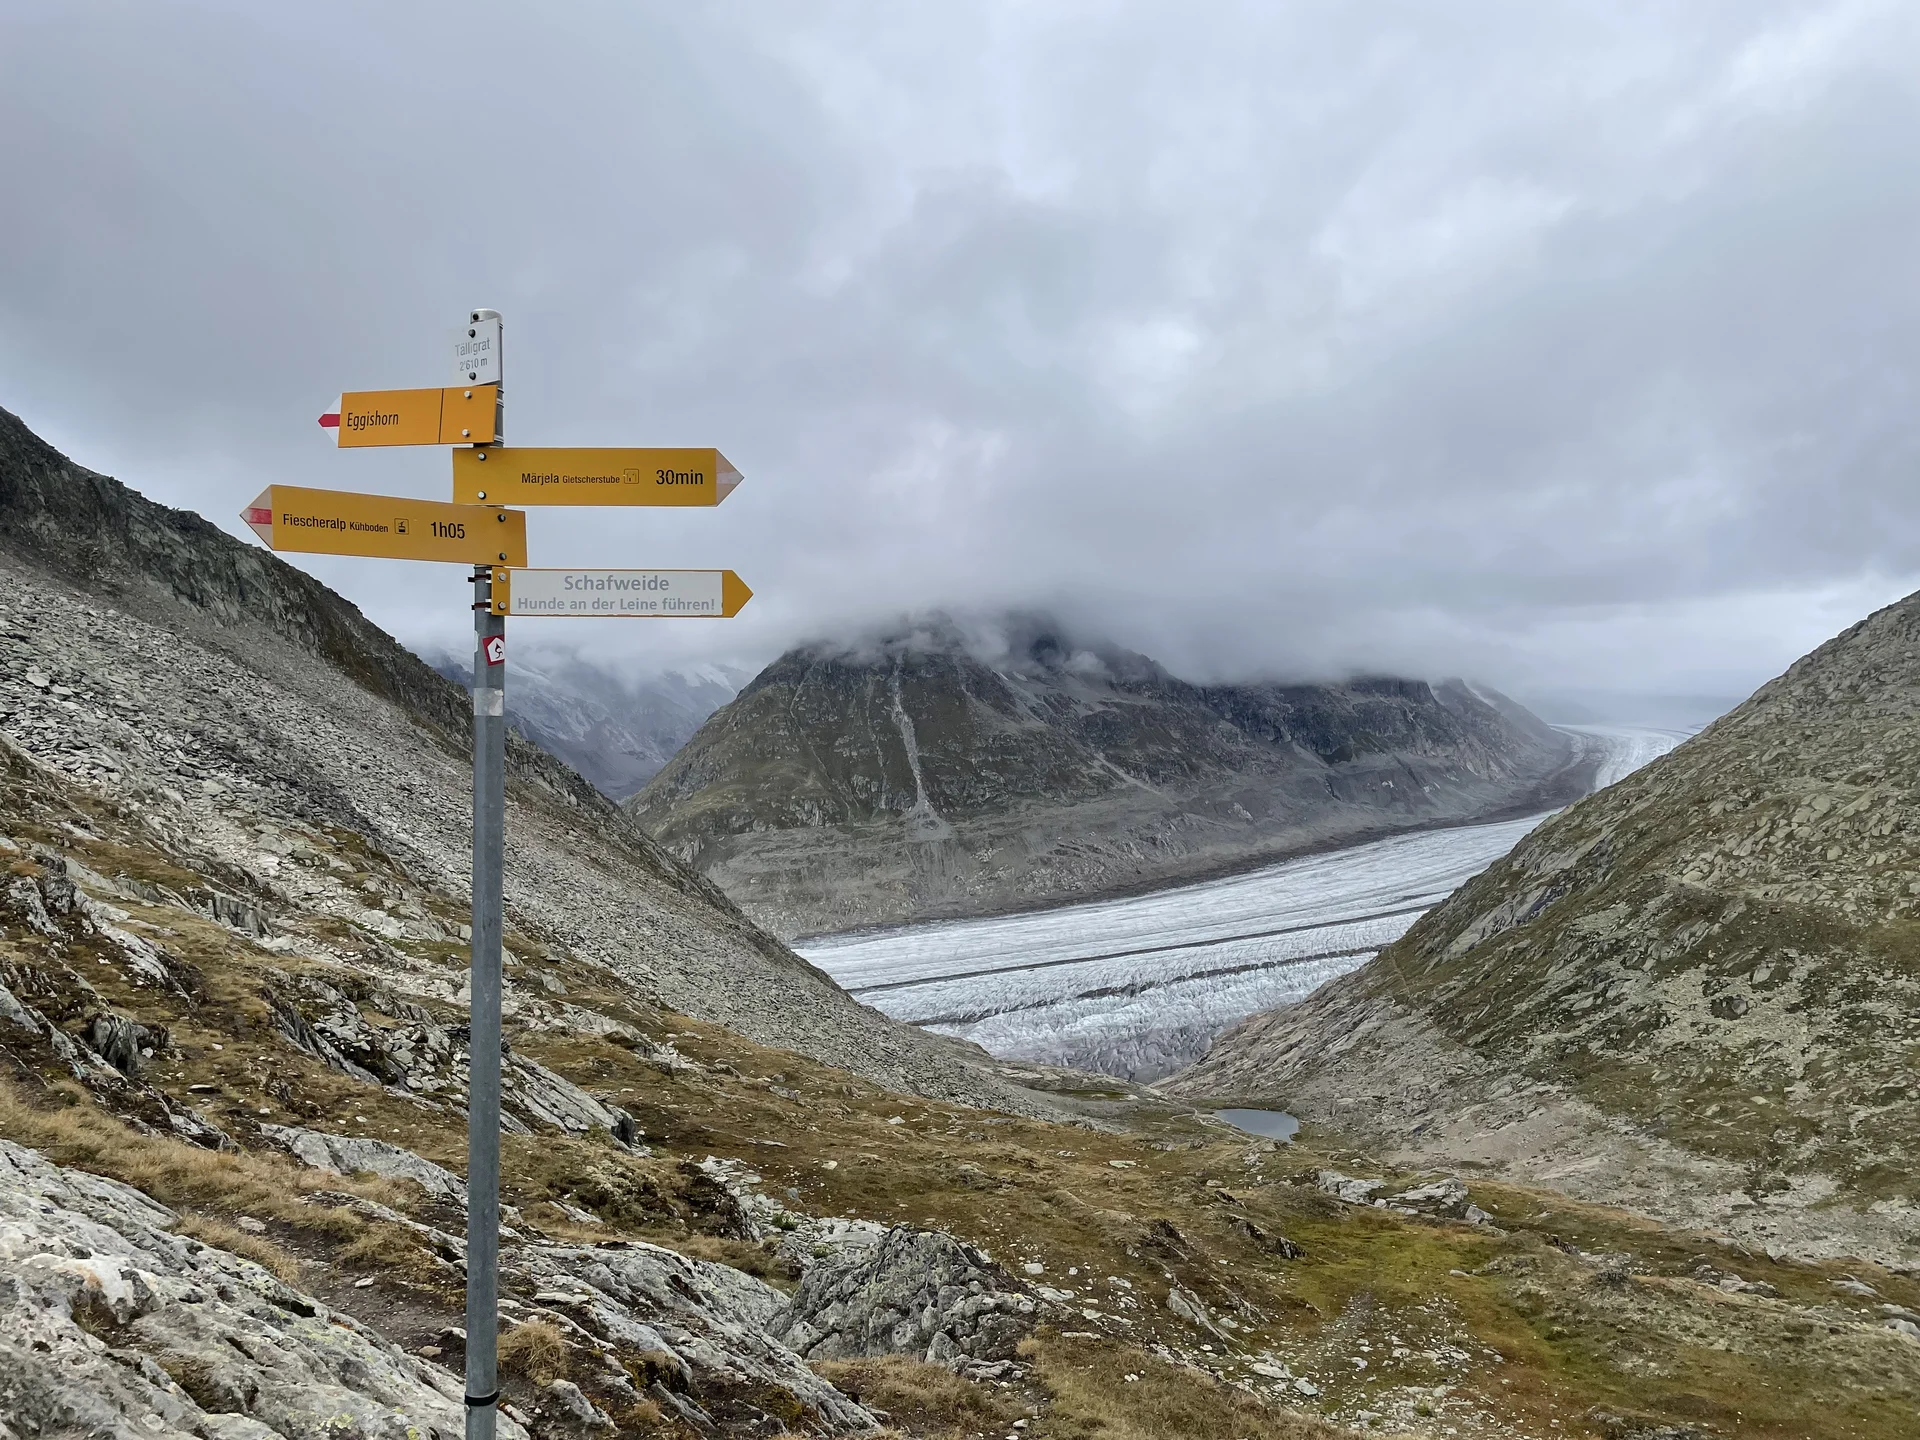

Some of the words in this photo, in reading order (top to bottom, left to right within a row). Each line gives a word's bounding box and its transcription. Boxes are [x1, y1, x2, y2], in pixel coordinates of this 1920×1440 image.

[455, 337, 490, 357] Tälligrat
[459, 358, 479, 371] 2'610
[480, 357, 488, 367] m
[347, 410, 399, 431] Eggishorn
[521, 472, 560, 486] Märjela
[562, 474, 620, 484] Gletscherstube
[655, 469, 704, 485] 30min
[283, 513, 346, 532] Fiescheralp
[349, 521, 389, 533] Kühboden
[430, 521, 465, 540] 1h05
[564, 574, 670, 591] Schafweide
[517, 597, 565, 610] Hunde
[569, 599, 587, 610] an
[592, 598, 615, 611] der
[619, 598, 657, 611] Leine
[661, 597, 715, 611] führen!
